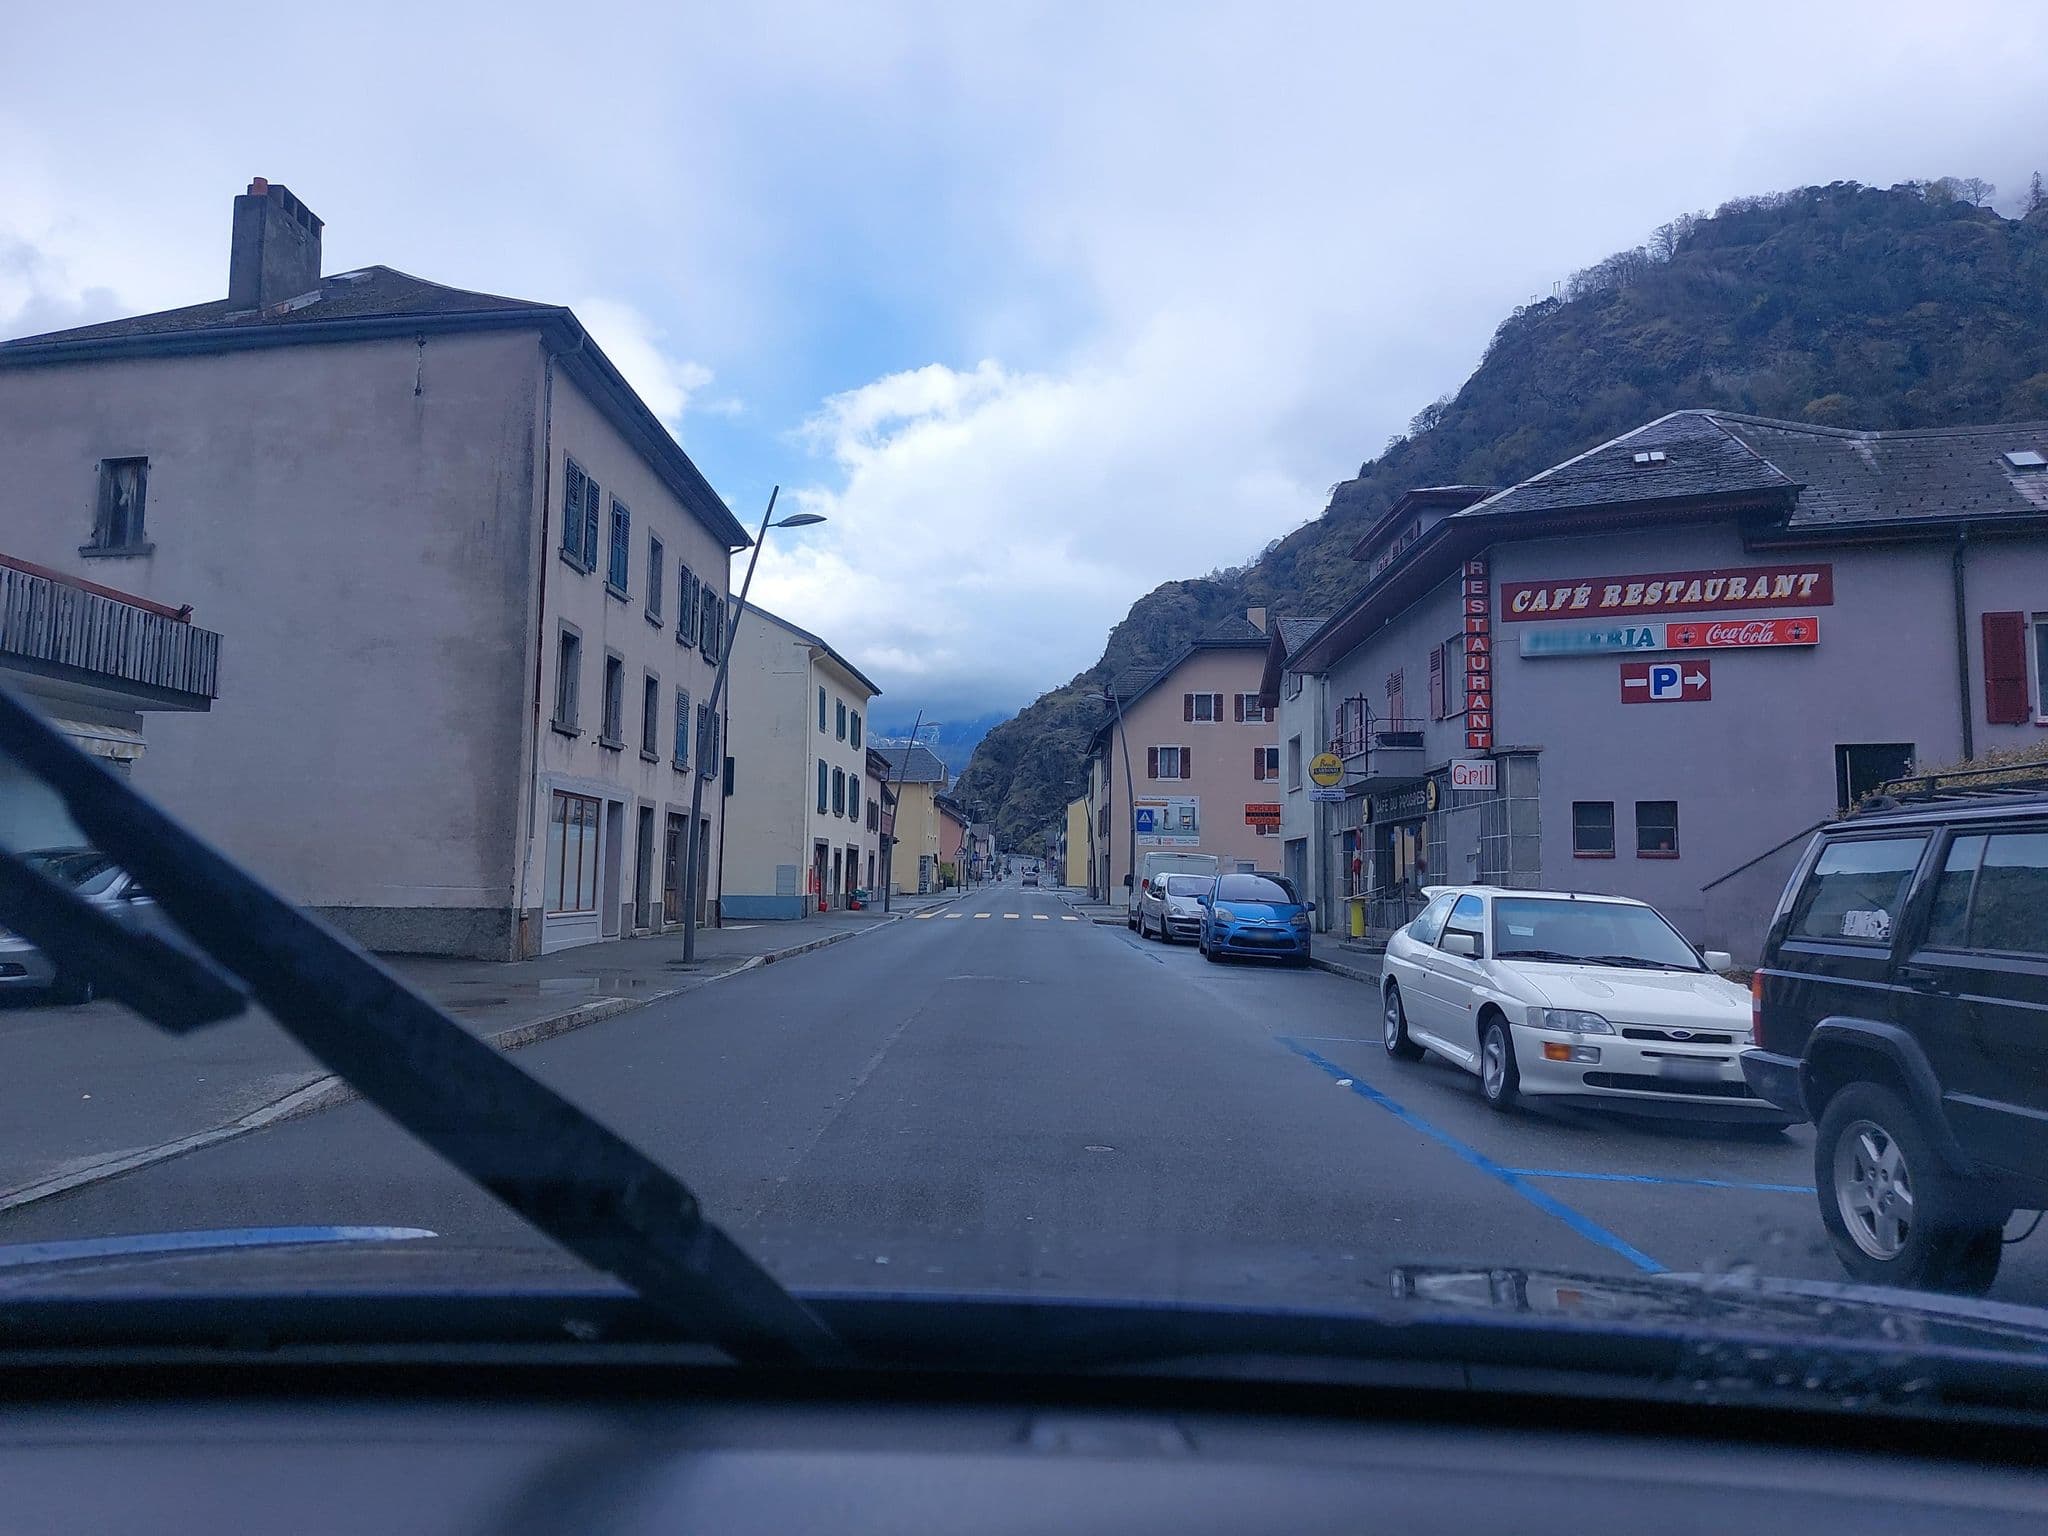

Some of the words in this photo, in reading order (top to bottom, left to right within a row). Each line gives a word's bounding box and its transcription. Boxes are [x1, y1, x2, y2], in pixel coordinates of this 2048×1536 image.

[1512, 583, 1592, 613] CAFÉ
[1599, 573, 1819, 609] RESTAURANT
[1705, 621, 1776, 645] Coca-Cola
[1470, 561, 1488, 746] RESTAURANT
[1653, 667, 1677, 696] P
[1453, 764, 1494, 786] Grill
